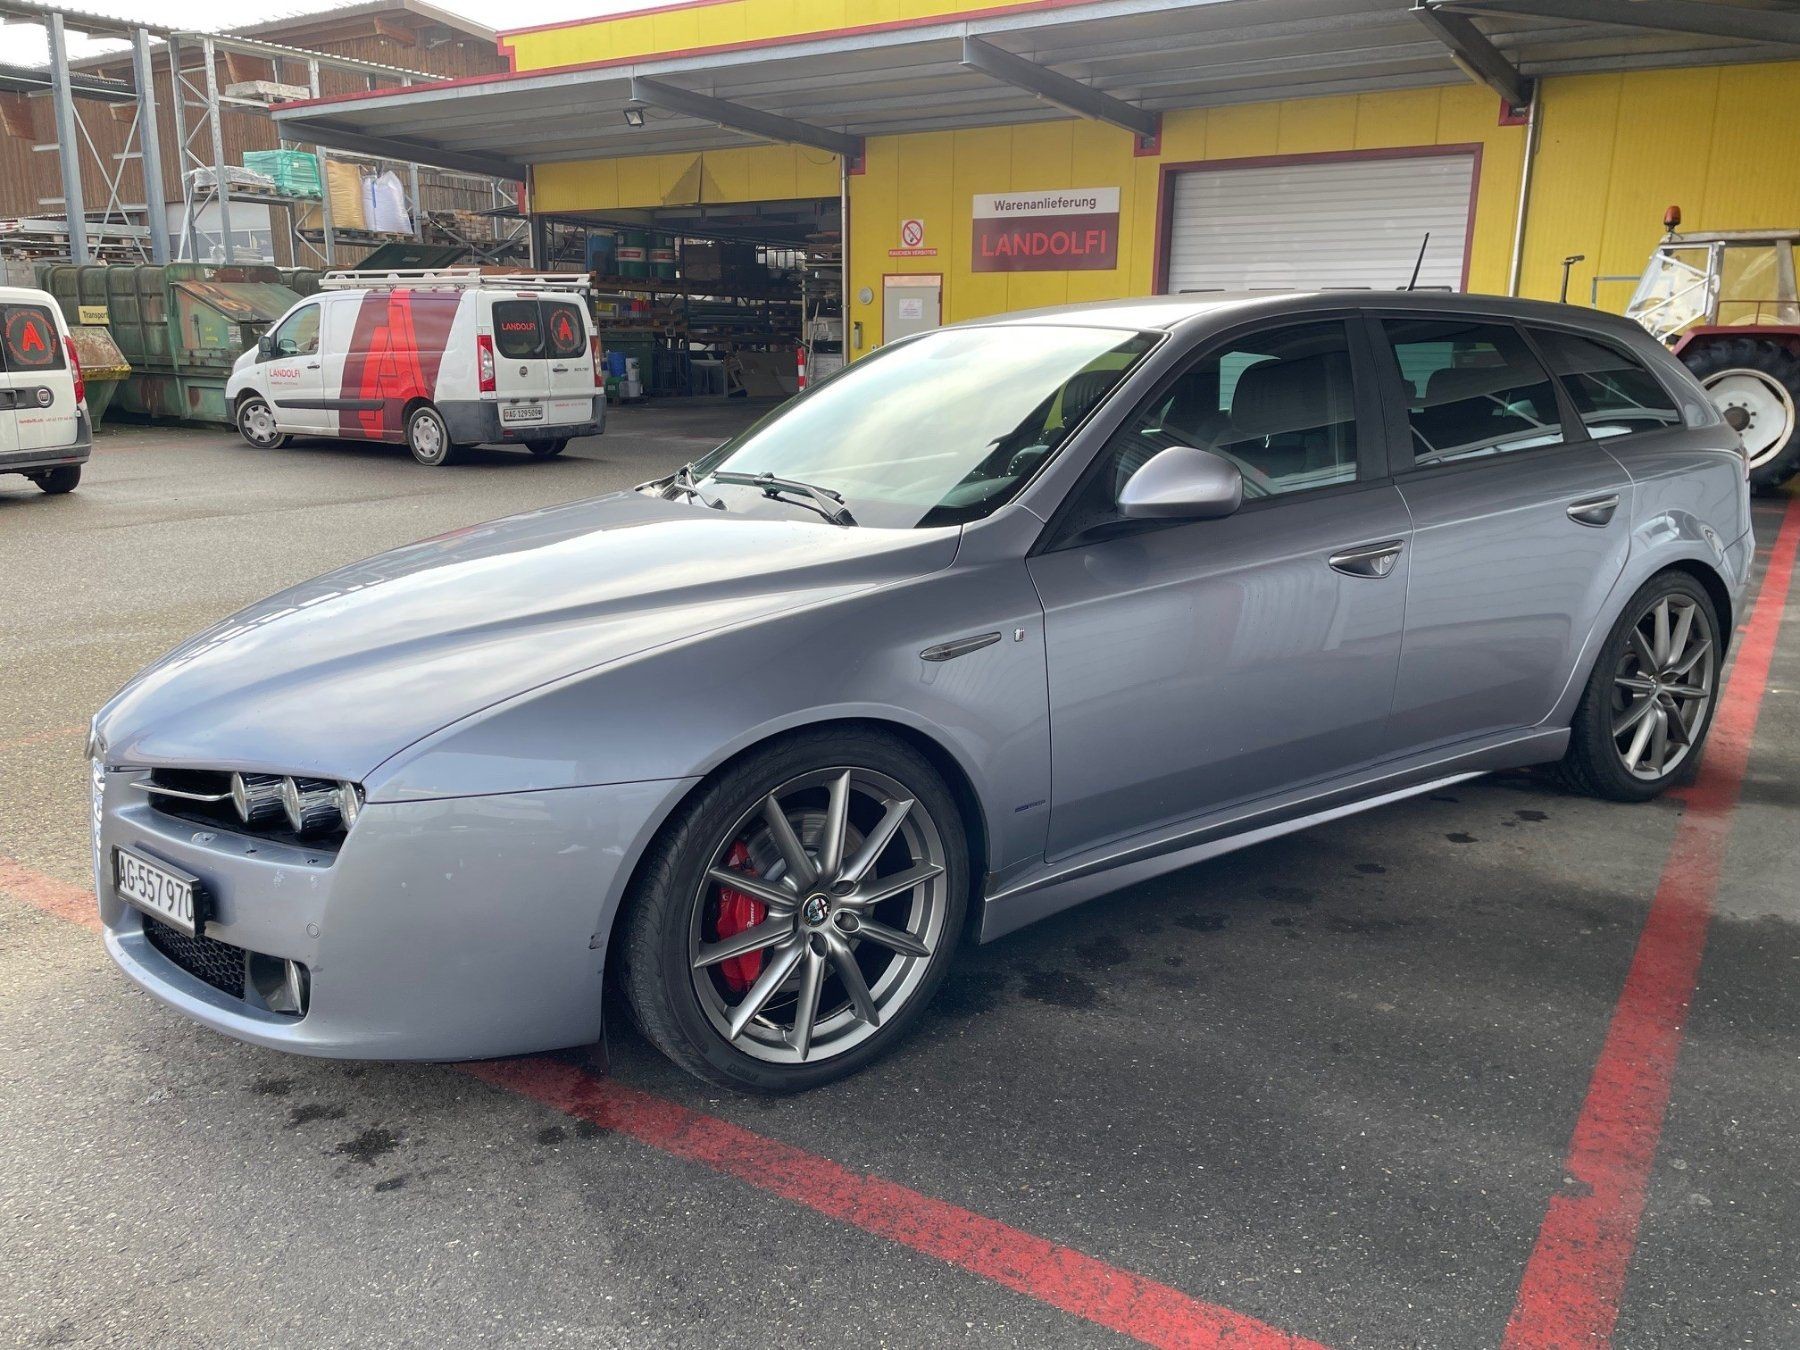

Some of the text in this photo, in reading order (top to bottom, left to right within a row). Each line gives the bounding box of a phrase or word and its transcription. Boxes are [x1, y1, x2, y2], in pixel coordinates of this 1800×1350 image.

[993, 197, 1097, 211] Warenanlieferung
[981, 230, 1106, 257] LANDOLFI
[502, 323, 535, 331] LANDOLFI
[270, 369, 300, 378] LANDOLFI
